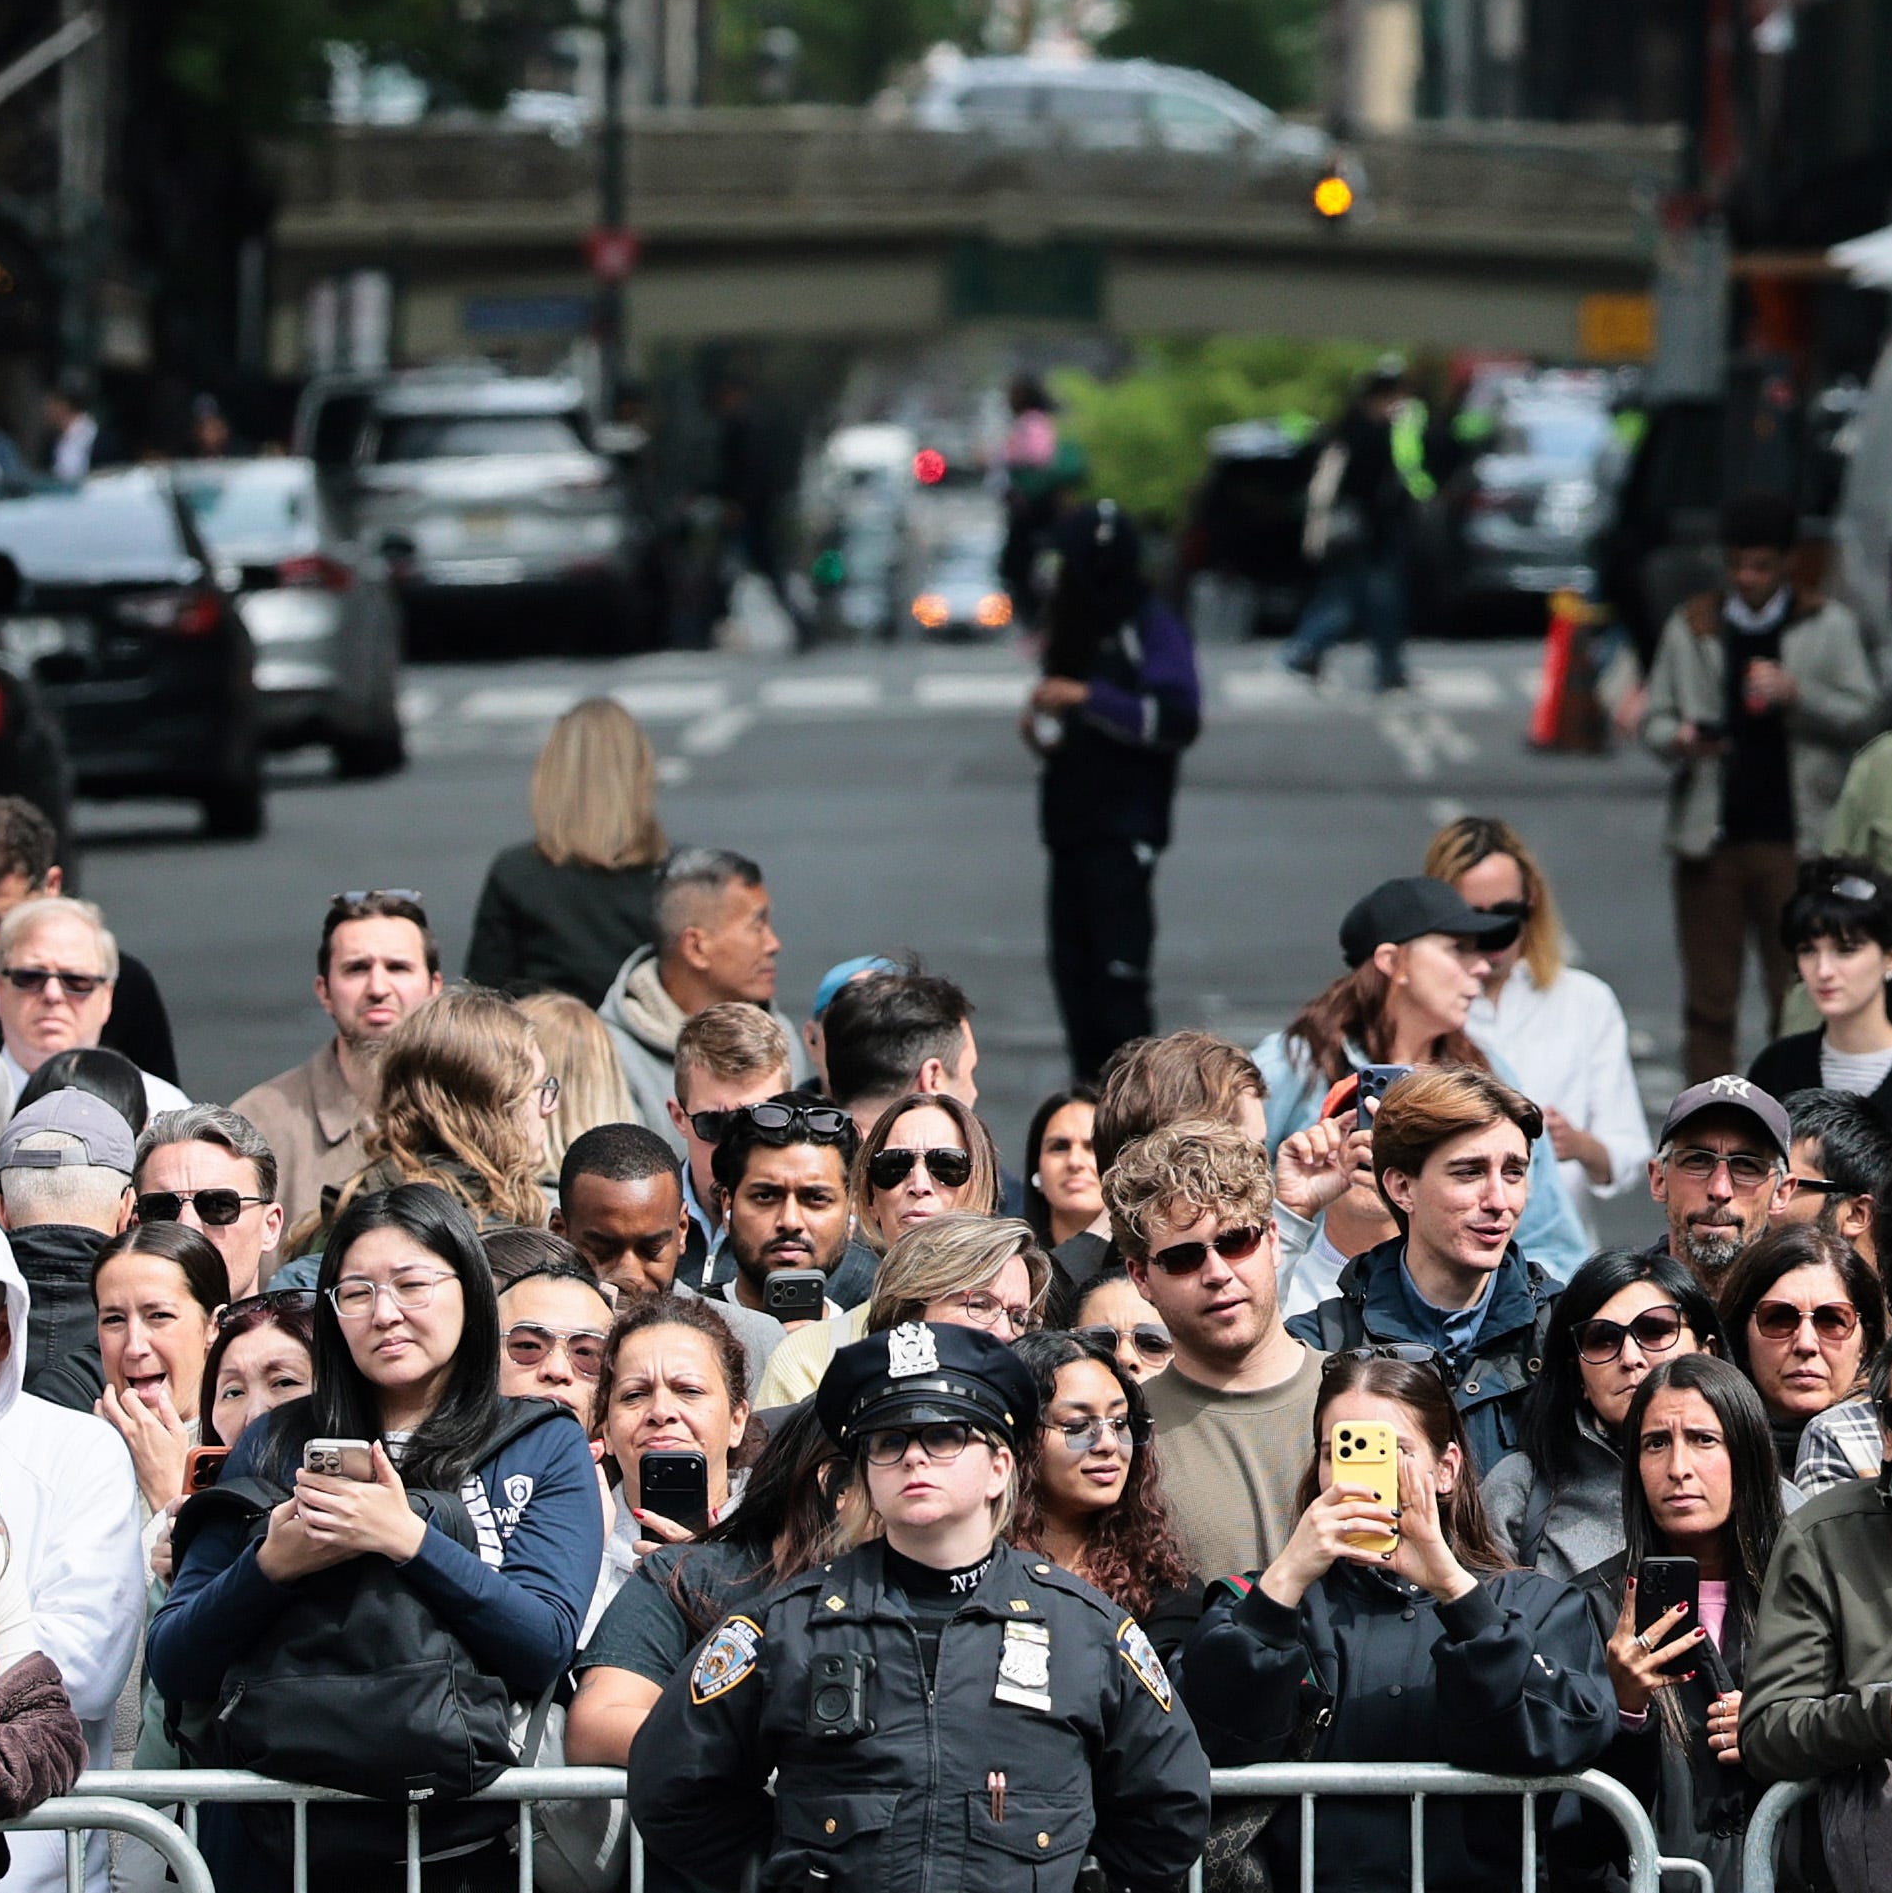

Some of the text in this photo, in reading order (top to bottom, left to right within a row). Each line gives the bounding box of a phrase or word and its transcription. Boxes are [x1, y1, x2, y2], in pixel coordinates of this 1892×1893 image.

[1709, 1074, 1752, 1099] NY
[950, 1559, 992, 1594] NYP
[703, 1663, 748, 1697] NEW YORK
